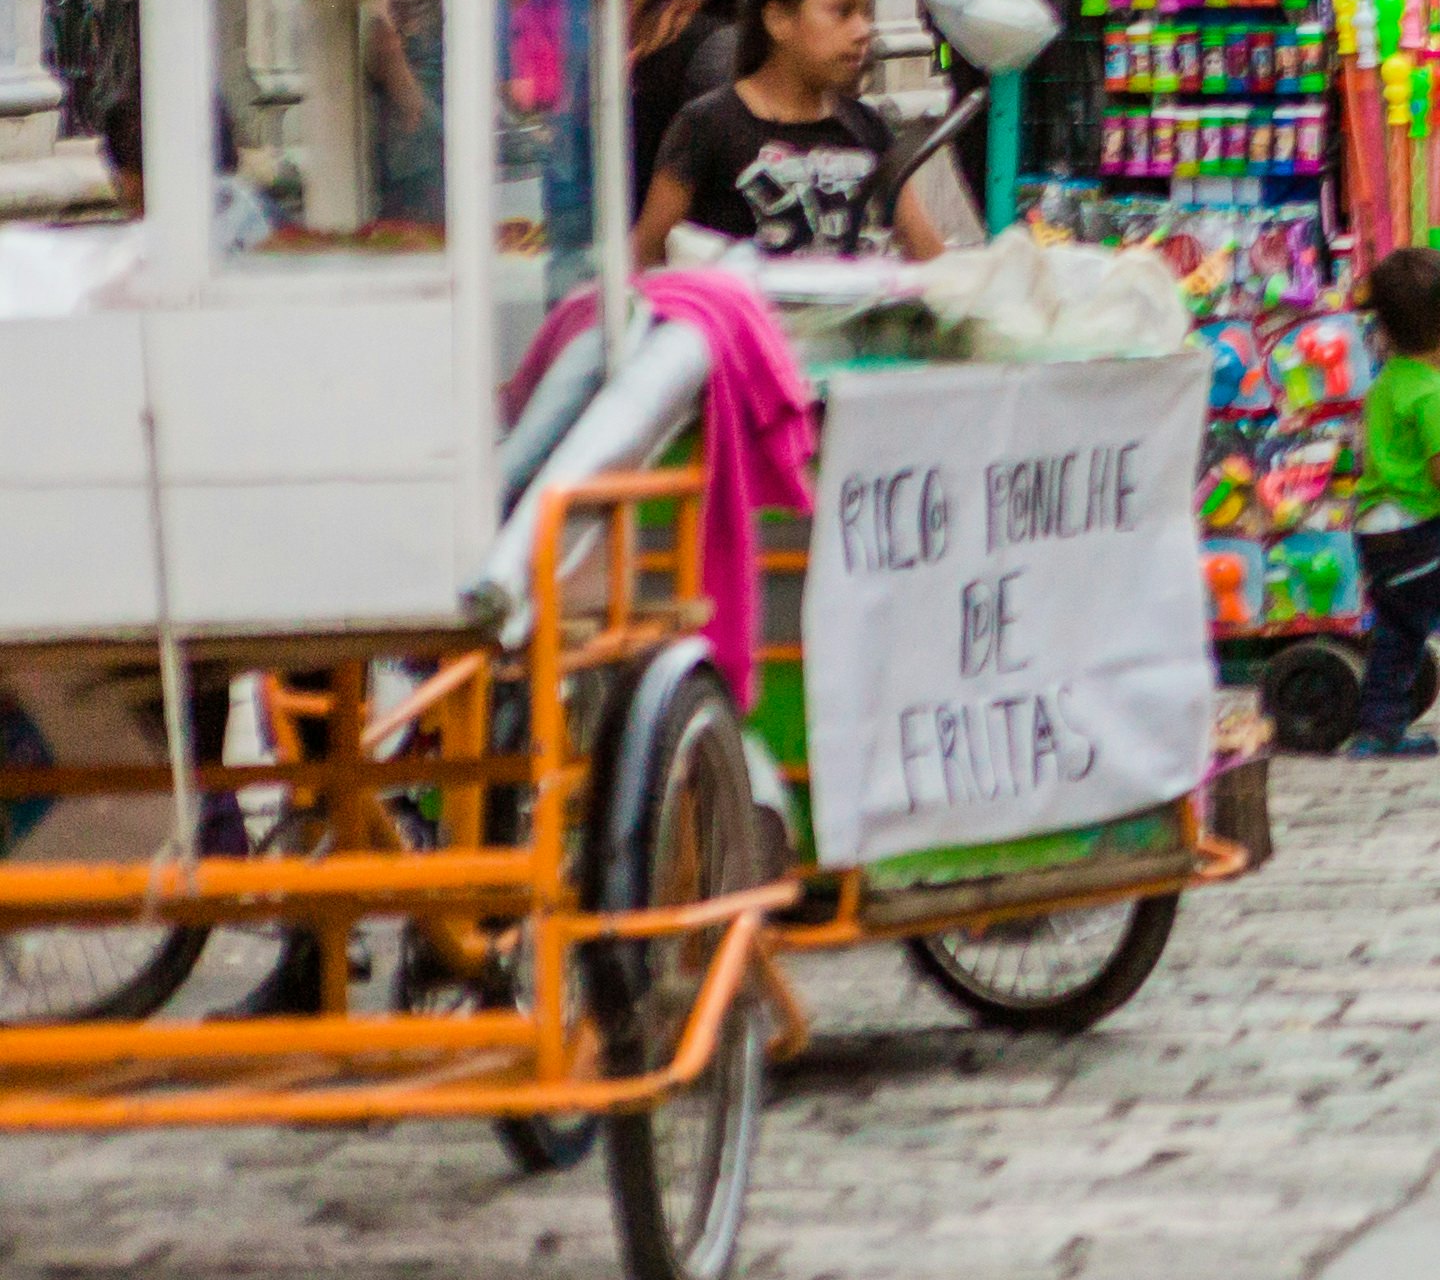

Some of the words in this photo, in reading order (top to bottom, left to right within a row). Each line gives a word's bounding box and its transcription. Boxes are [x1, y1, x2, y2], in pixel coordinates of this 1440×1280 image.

[839, 463, 951, 576] RICO
[985, 440, 1141, 557] PONCHE
[959, 566, 1034, 679] DE
[899, 679, 1098, 815] FRUTAS
